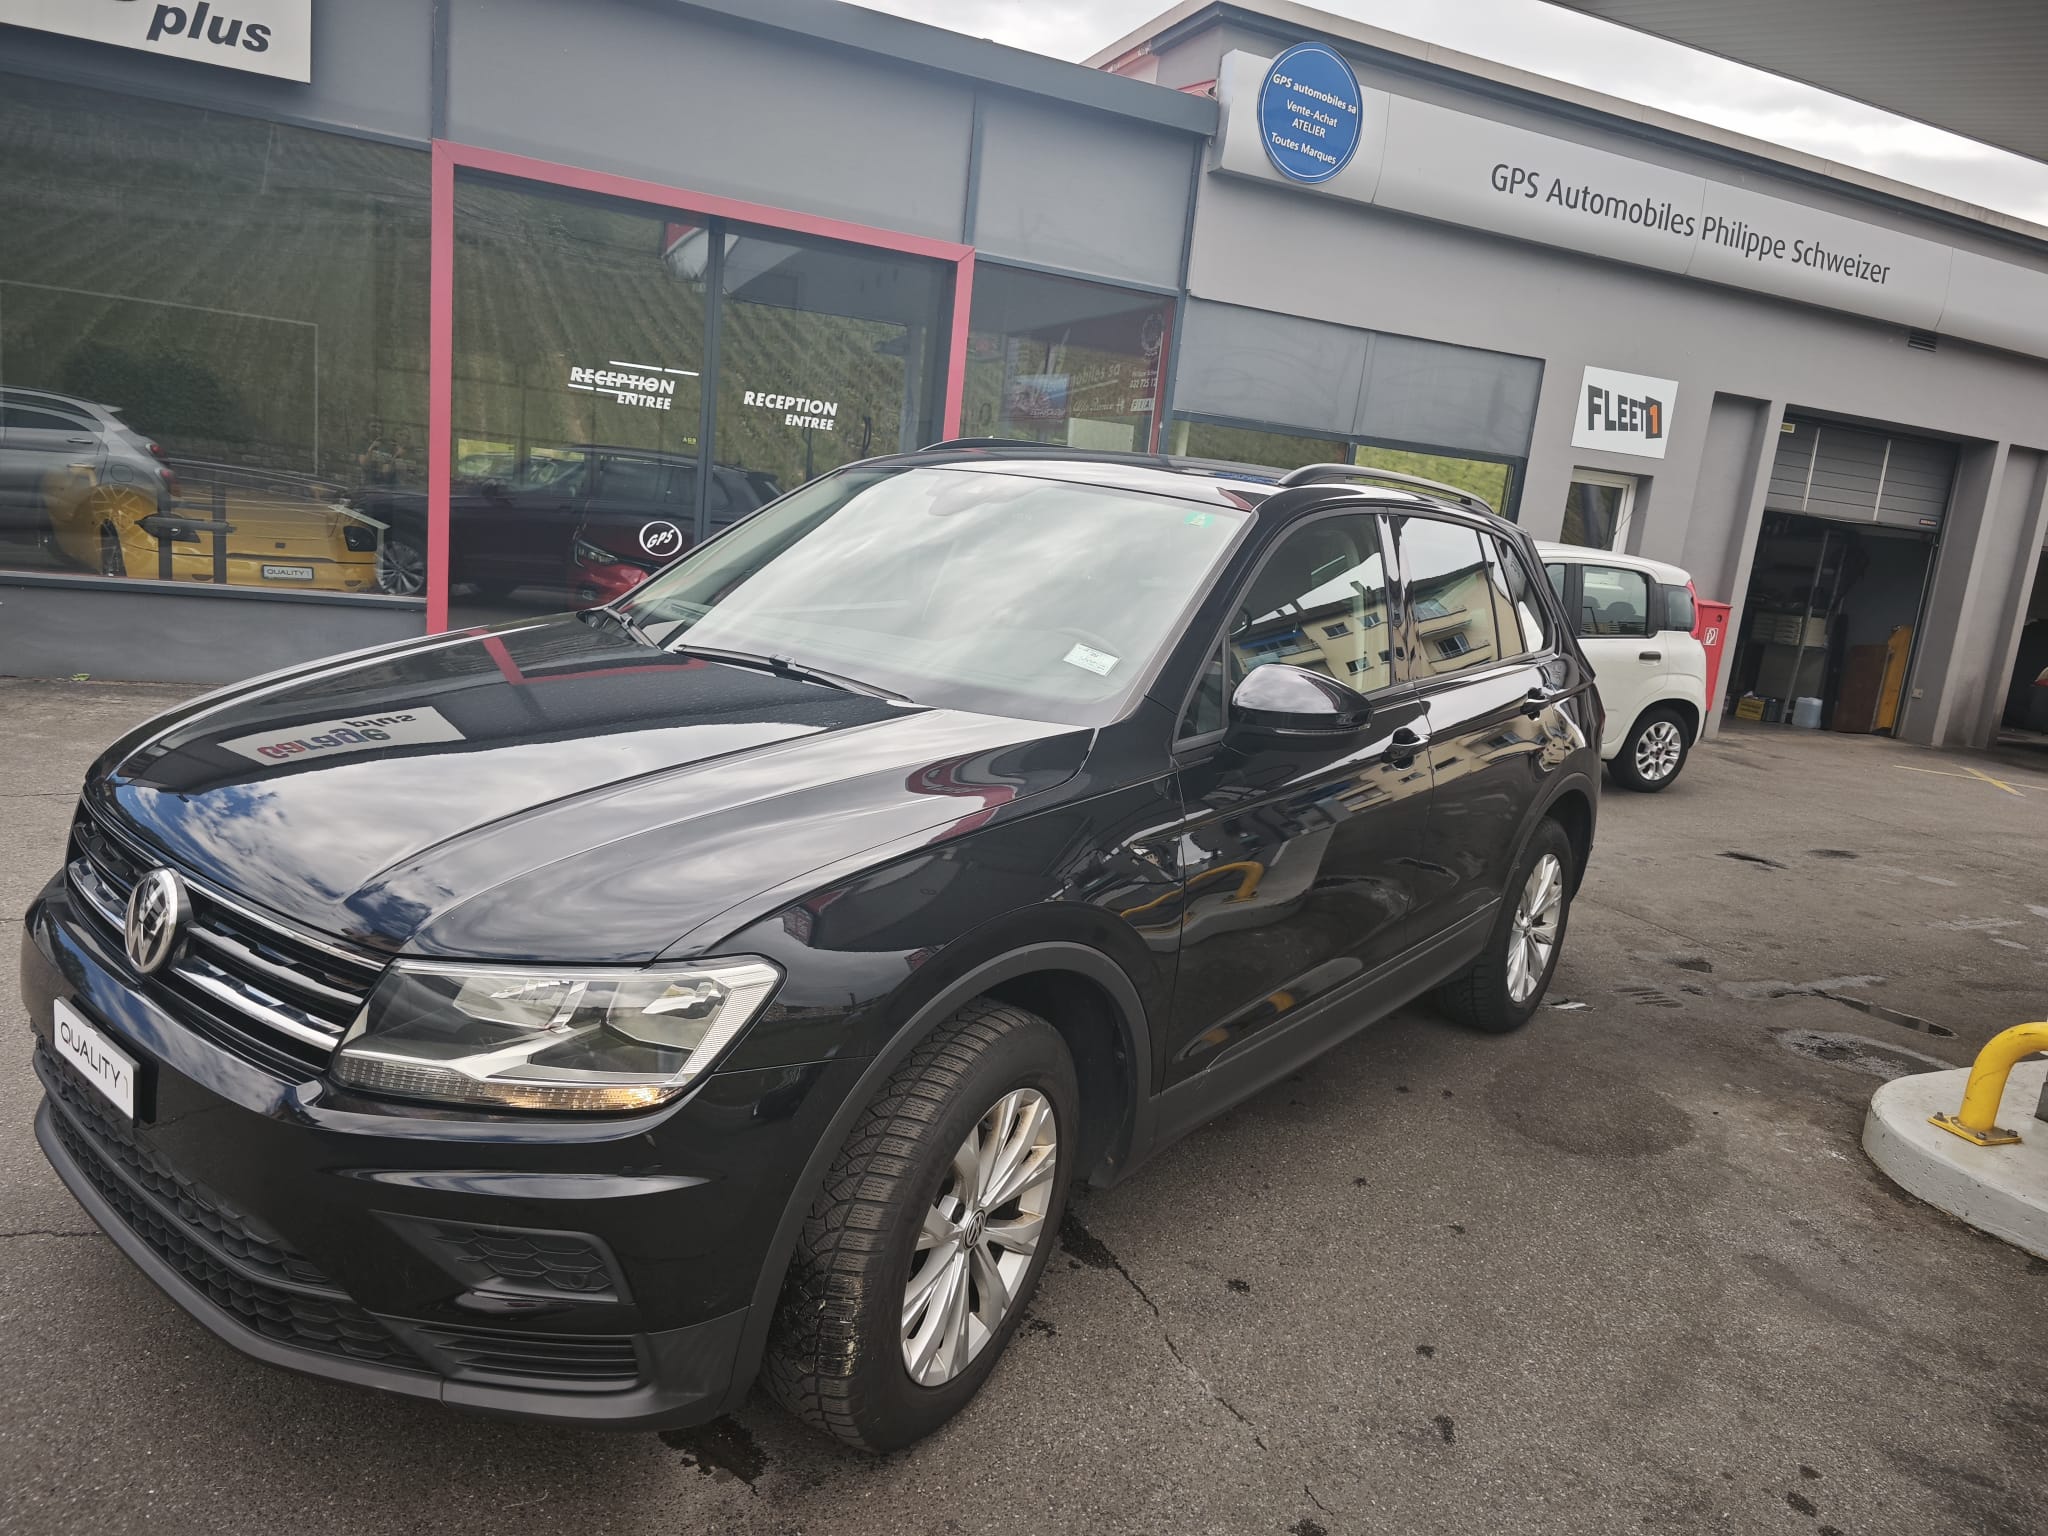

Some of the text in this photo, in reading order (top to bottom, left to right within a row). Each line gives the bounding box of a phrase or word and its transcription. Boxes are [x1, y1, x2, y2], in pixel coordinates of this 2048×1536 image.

[146, 1, 272, 53] plus
[1273, 73, 1357, 115] GPS automobiles sa
[1287, 99, 1338, 128] Vente-Achat
[1292, 117, 1326, 139] ATELIER
[1271, 131, 1337, 165] Toutes Marques
[1491, 163, 1891, 285] GPS Automobiles Philippe Schweizer
[570, 366, 676, 395] RECEPTION
[616, 392, 672, 411] ENTREE
[743, 390, 838, 417] RECEPTION
[784, 413, 834, 431] ENTREE
[646, 529, 675, 549] GPS
[266, 568, 305, 576] QUALITY
[60, 1021, 121, 1089] QUALITY
